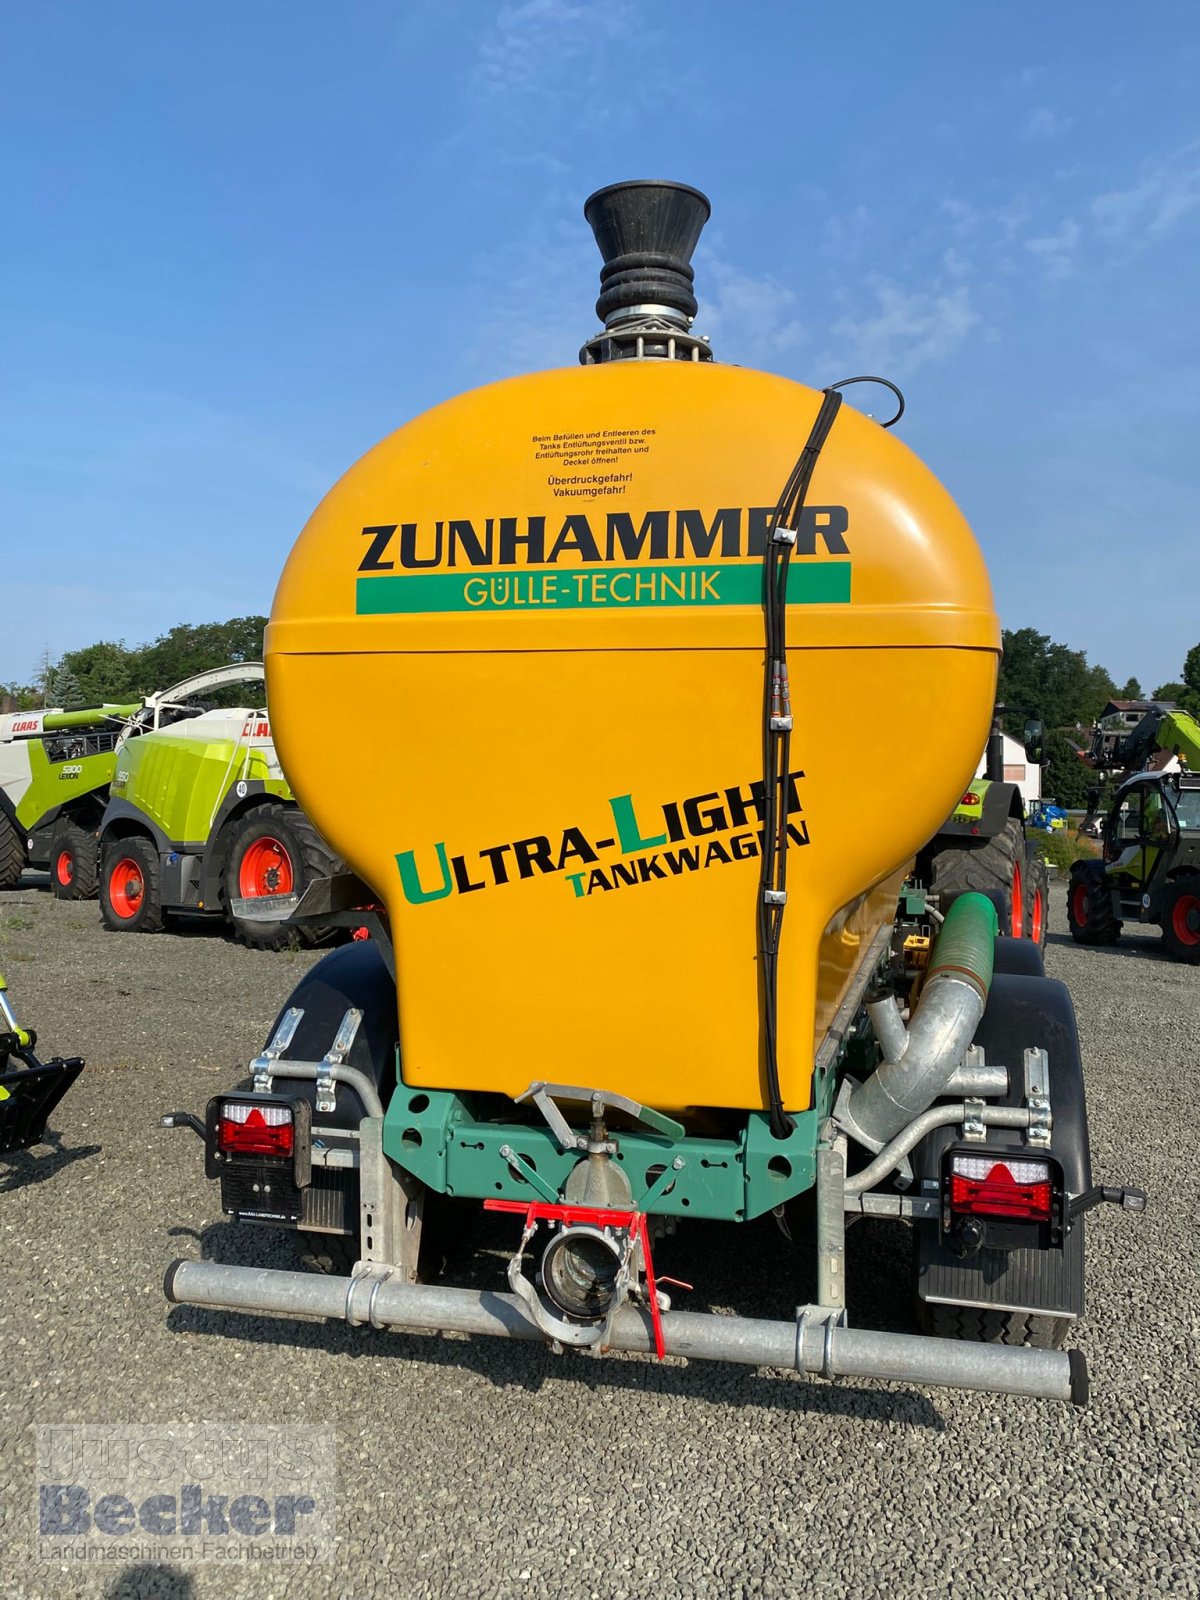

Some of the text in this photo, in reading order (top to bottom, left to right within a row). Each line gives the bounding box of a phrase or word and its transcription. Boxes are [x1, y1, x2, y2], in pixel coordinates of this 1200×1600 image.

[532, 428, 656, 443] Beim Befüllen und Entleeren des
[563, 437, 627, 449] Entlüftungsventil
[628, 437, 646, 445] bzw.
[535, 446, 649, 459] Entlüftungsrohr freihalten und
[563, 456, 619, 466] Deckel öffnen!
[547, 473, 633, 486] Überdruckgefahr!
[553, 485, 626, 498] Vakuumgefahr!
[464, 571, 721, 605] GÜLLE-TECHNIK
[12, 720, 39, 732] CLAAS
